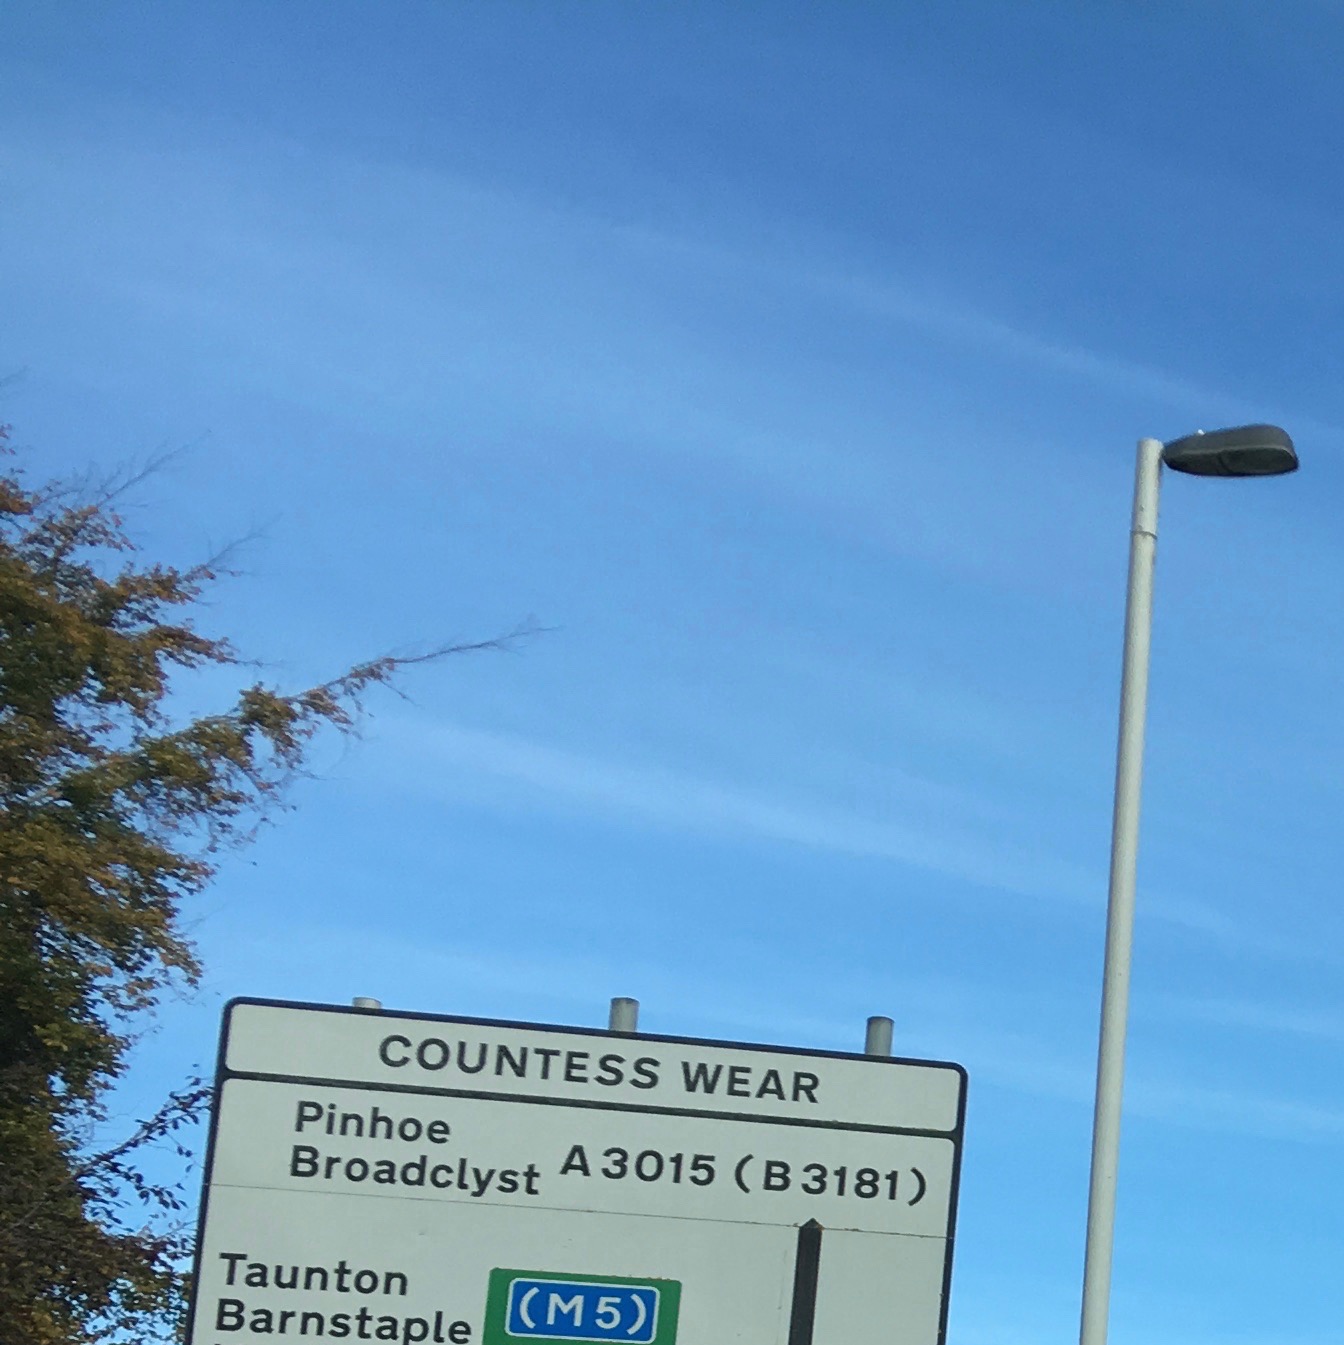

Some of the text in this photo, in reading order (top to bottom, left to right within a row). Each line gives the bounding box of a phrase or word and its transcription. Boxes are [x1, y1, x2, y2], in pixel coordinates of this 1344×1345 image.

[379, 1035, 822, 1104] COUNTESS WEAR
[294, 1100, 451, 1146] Pinhoe
[290, 1145, 928, 1207] Broadclyst A3015 (B3181)
[219, 1253, 410, 1297] Taunton
[517, 1286, 648, 1336] (M5)
